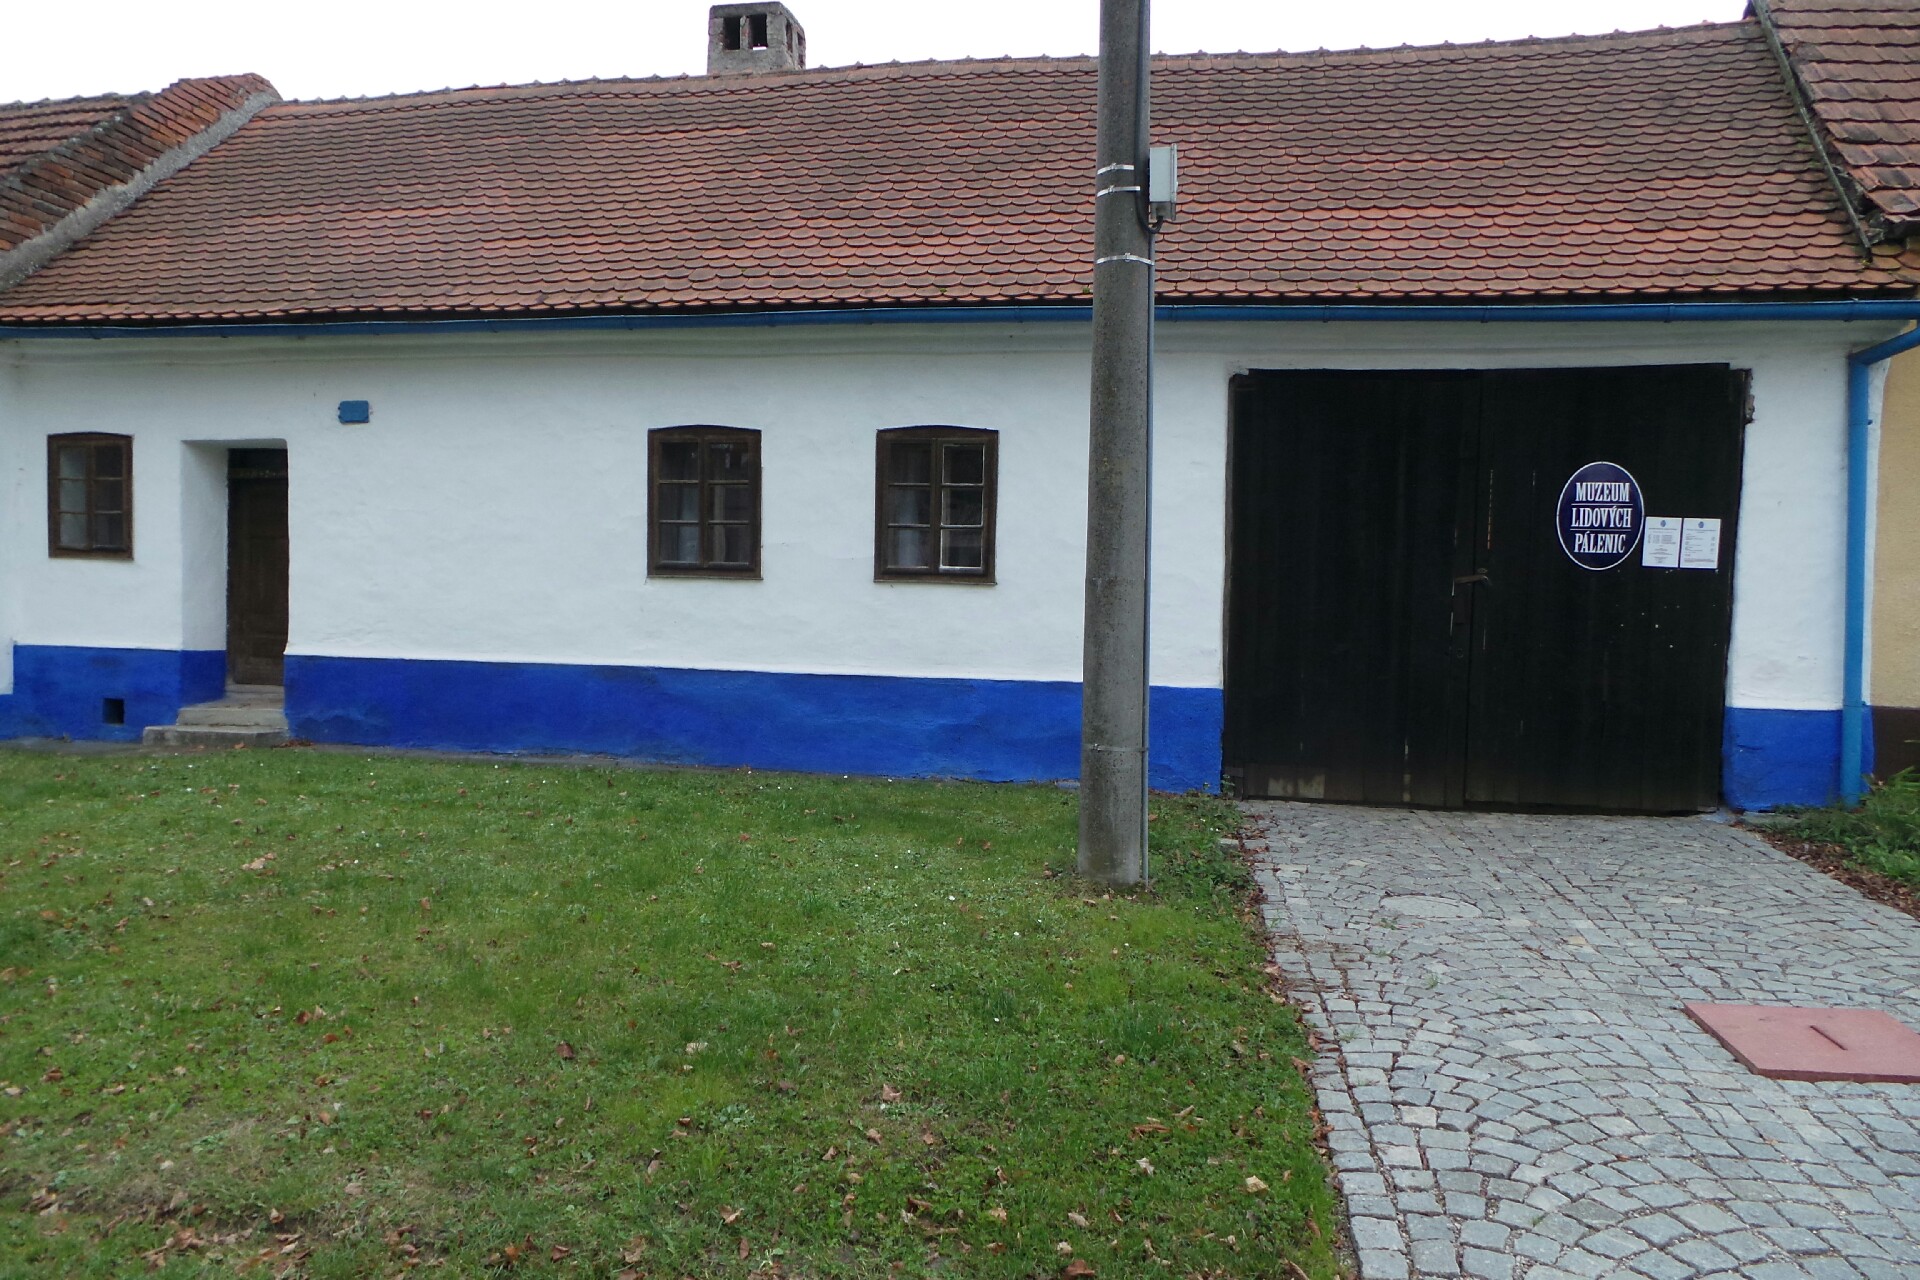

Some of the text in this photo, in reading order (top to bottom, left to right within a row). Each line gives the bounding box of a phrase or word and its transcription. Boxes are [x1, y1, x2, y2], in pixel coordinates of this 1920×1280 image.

[1575, 482, 1630, 502] MUZEUM
[1571, 506, 1633, 528] LIDOVÝCH
[1573, 531, 1626, 554] PÁLENIC
